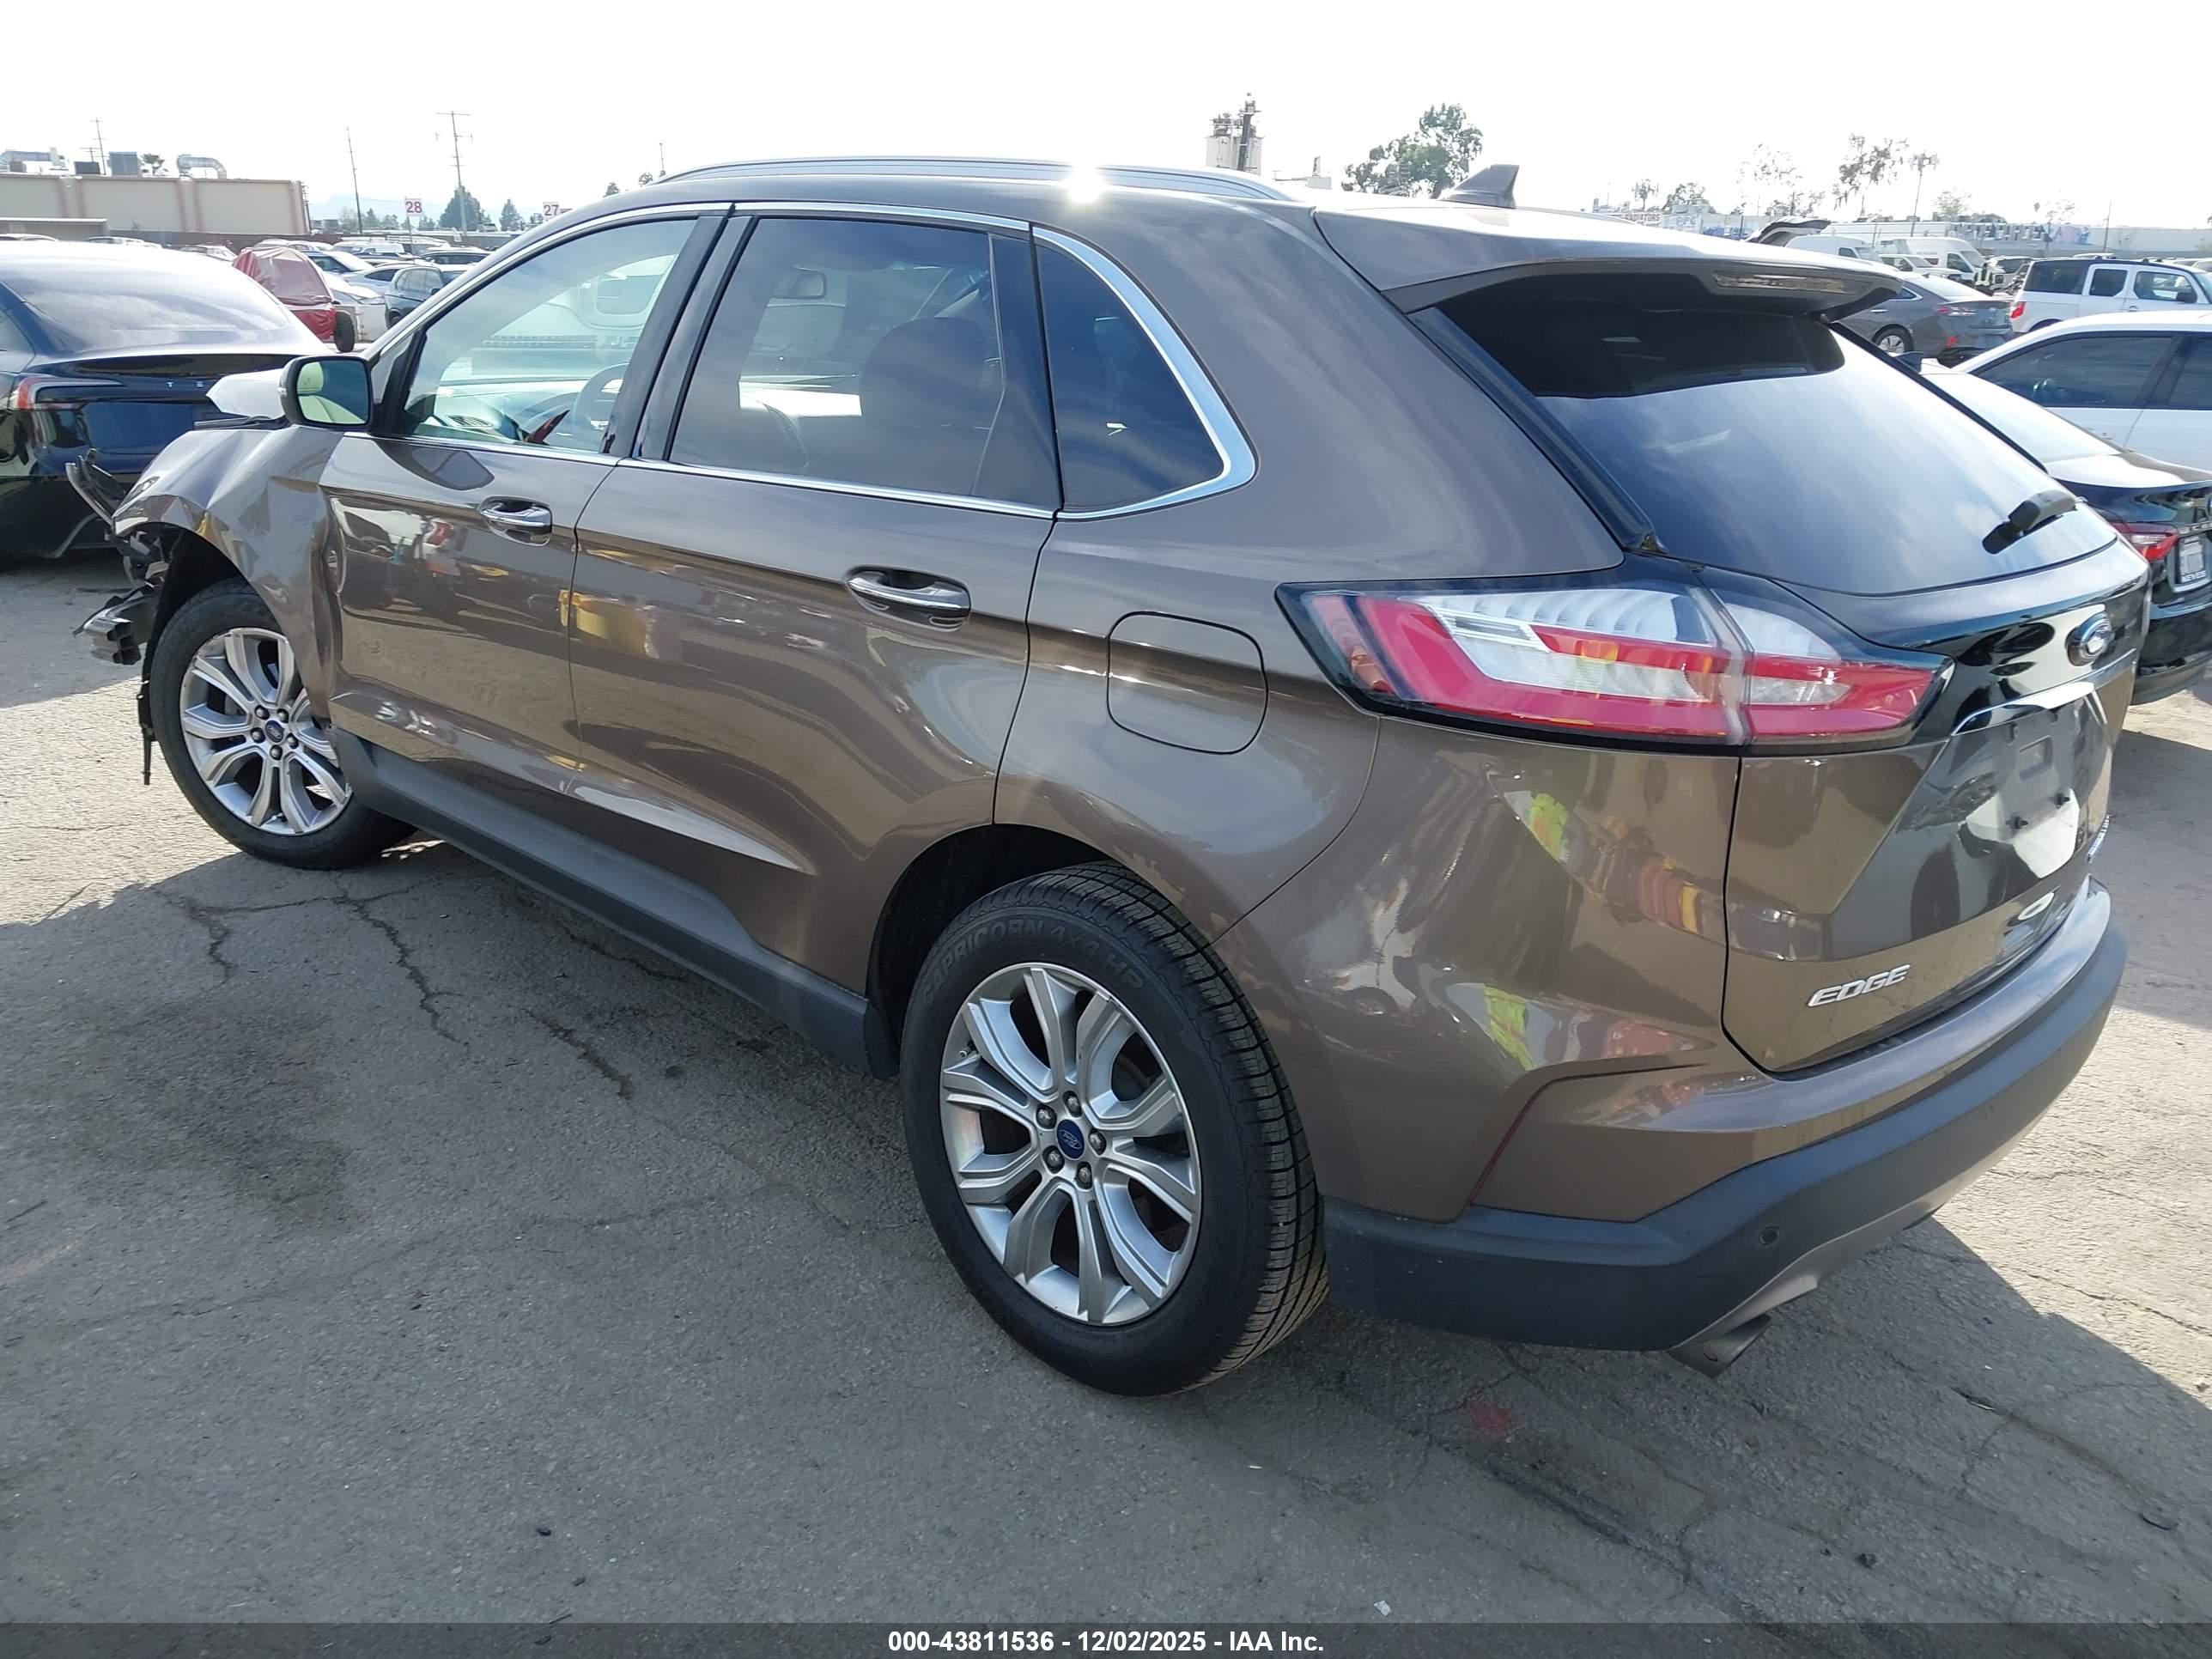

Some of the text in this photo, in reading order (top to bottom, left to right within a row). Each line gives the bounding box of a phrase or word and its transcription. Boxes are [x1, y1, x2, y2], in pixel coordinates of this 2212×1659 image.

[405, 201, 422, 213] 28
[544, 204, 559, 216] 27
[922, 919, 1045, 1004] CAPRICORN
[1807, 963, 1911, 1007] EDGE
